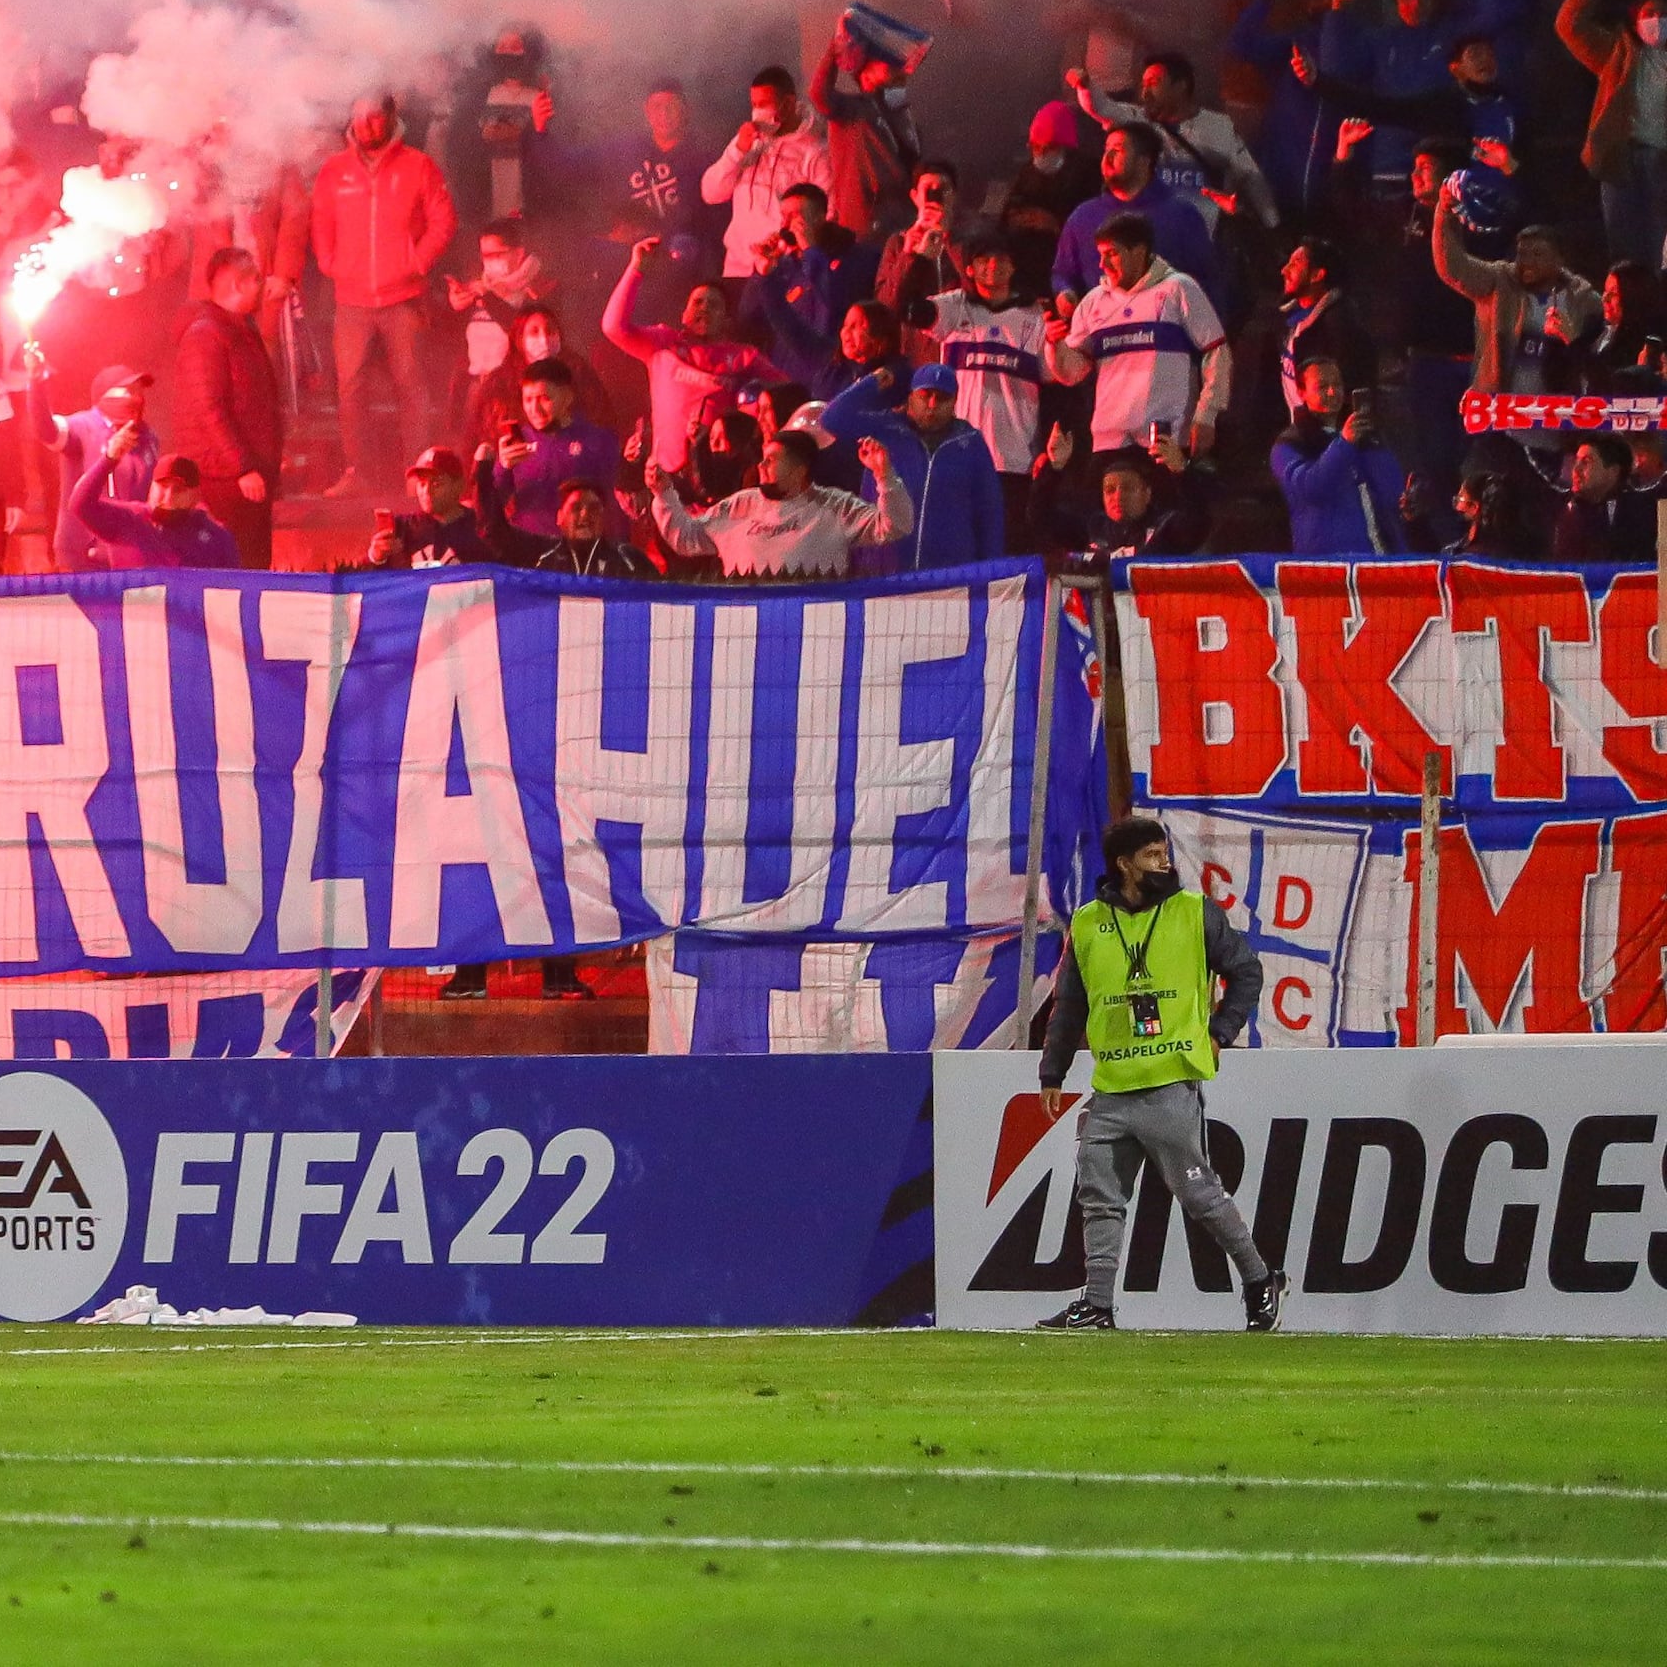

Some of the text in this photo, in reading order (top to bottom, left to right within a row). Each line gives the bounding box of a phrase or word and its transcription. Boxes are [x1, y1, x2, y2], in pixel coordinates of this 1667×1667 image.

[1462, 389, 1609, 434] BKTS
[1099, 1039, 1194, 1064] PASAPELOTAS
[142, 1127, 616, 1265] FIFA 22
[967, 1093, 1667, 1294] BRIDGE
